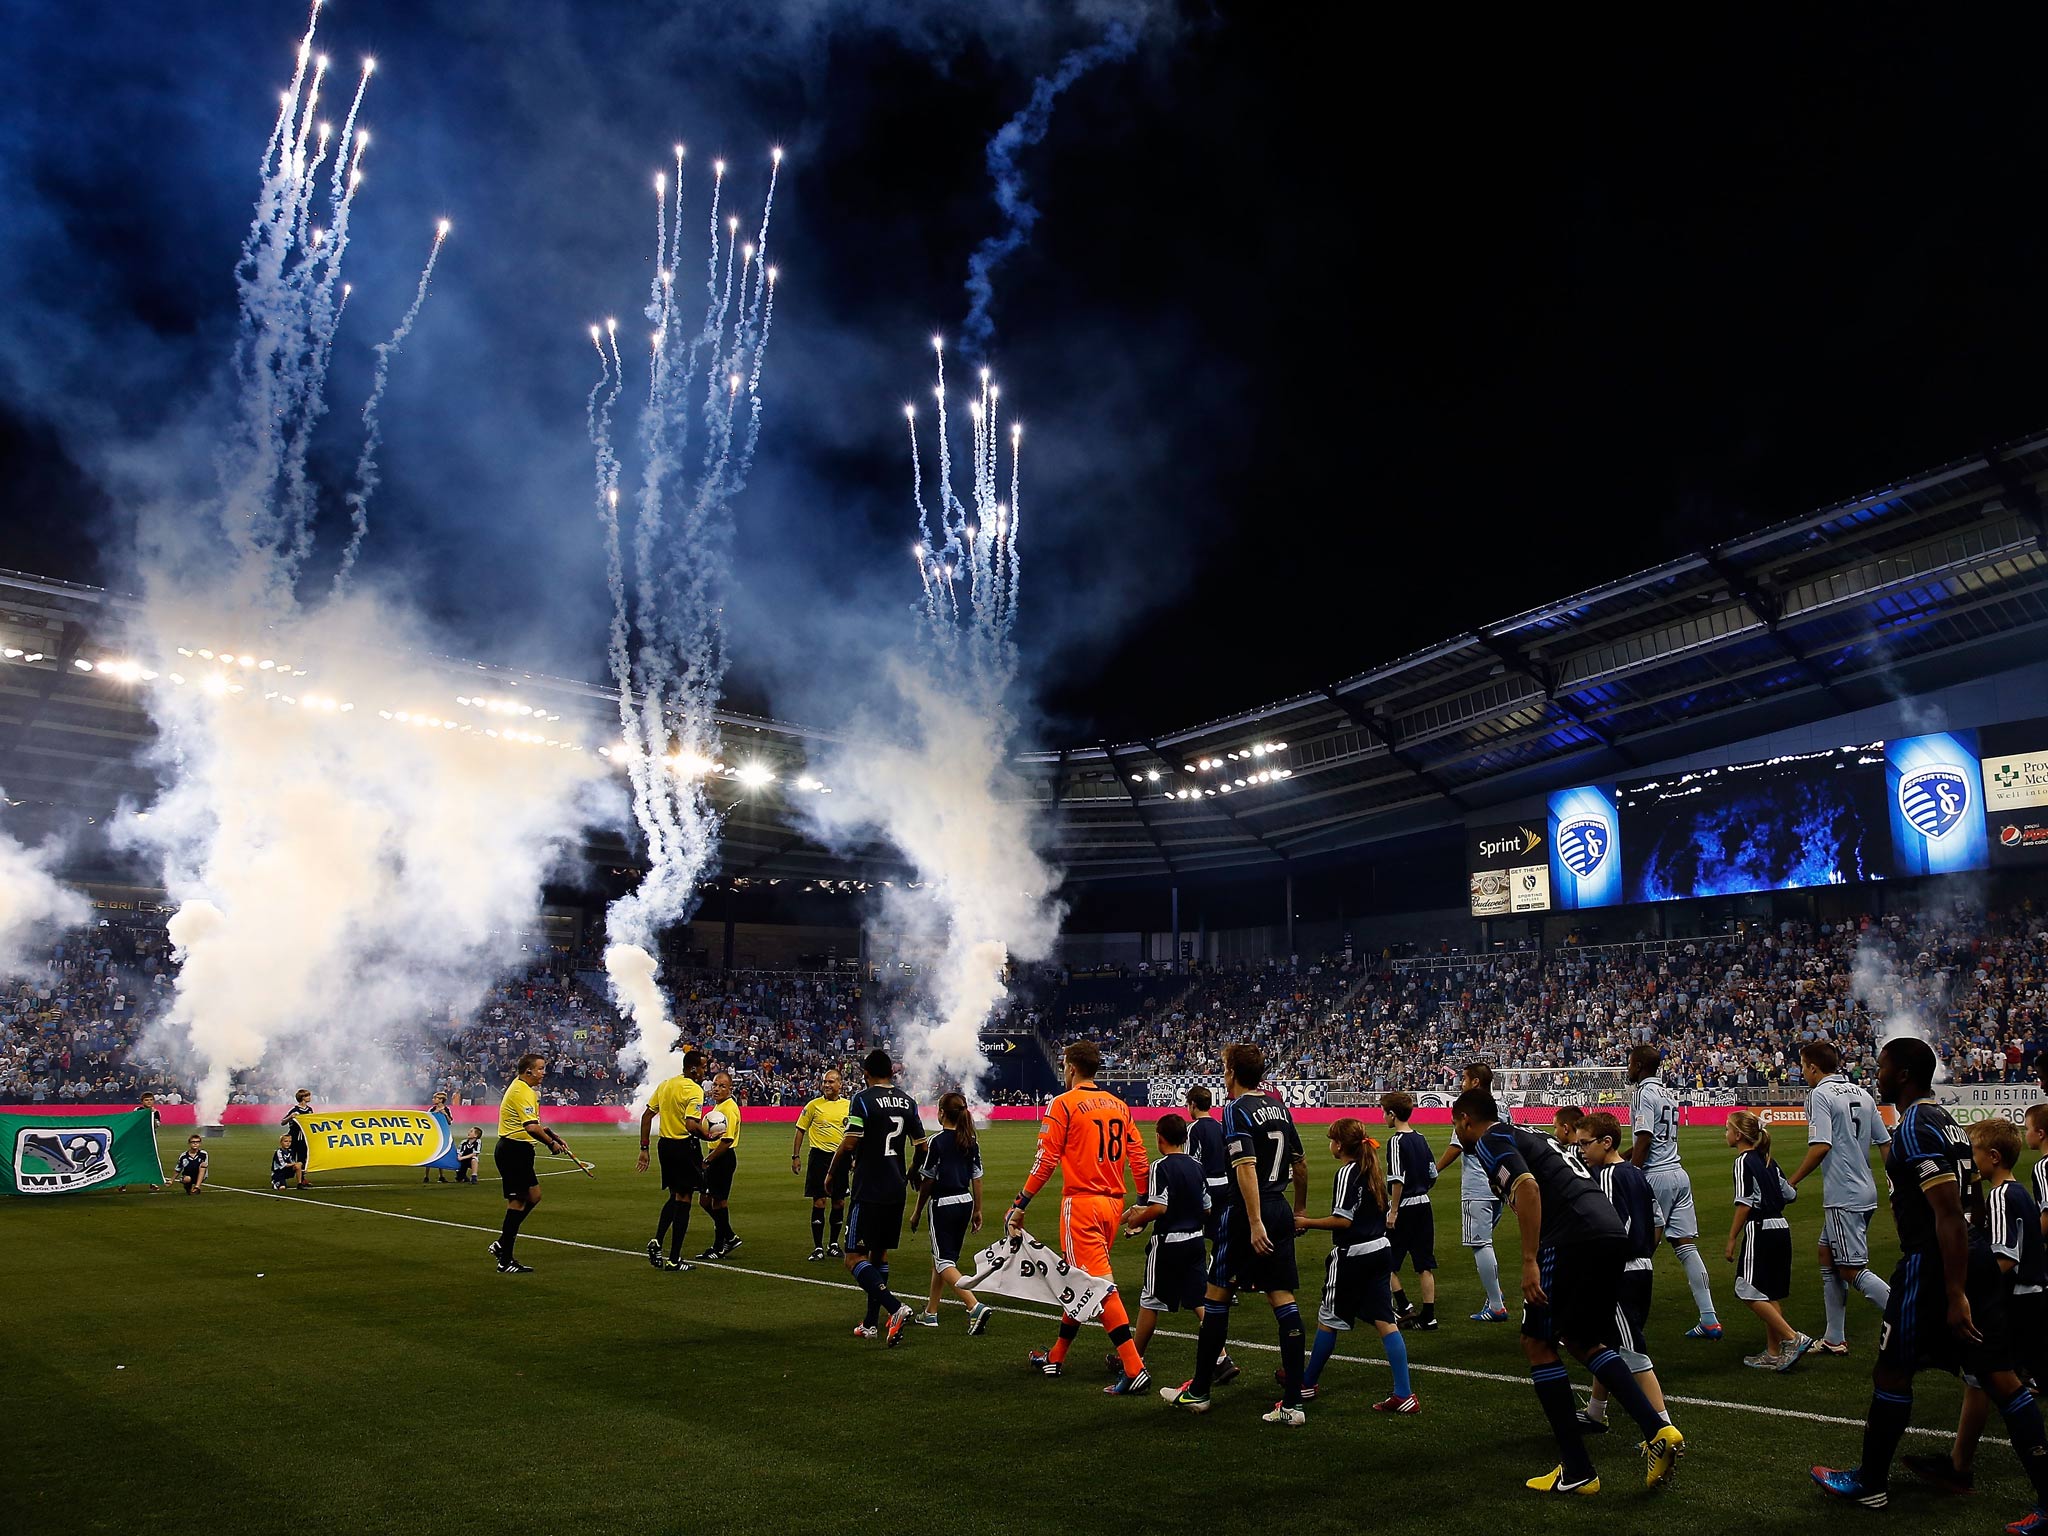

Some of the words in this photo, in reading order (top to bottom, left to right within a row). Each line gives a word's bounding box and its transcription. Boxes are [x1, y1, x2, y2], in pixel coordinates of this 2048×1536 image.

[1905, 773, 1961, 790] SPORTING
[1997, 791, 2020, 800] Well
[1562, 822, 1604, 836] SPORTING
[1480, 836, 1520, 858] Sprint
[980, 1042, 1004, 1052] Sprint
[1152, 1084, 1173, 1092] SOUTH
[1291, 1085, 1317, 1105] SC
[1973, 1089, 1988, 1101] AD
[1995, 1089, 2037, 1100] ASTRA
[876, 1096, 910, 1110] VALDES
[1760, 1109, 1773, 1123] G
[1849, 1102, 1862, 1141] 5
[310, 1119, 344, 1134] MY
[350, 1117, 412, 1129] GAME
[415, 1118, 432, 1129] IS
[327, 1133, 375, 1149] FAIR
[379, 1132, 425, 1146] PLAY
[884, 1116, 905, 1156] 2
[1092, 1118, 1124, 1162] 18
[1267, 1131, 1285, 1182] 7
[21, 1162, 108, 1186] MLS
[51, 1182, 81, 1191] LEAGUE
[82, 1171, 111, 1184] SOCCER
